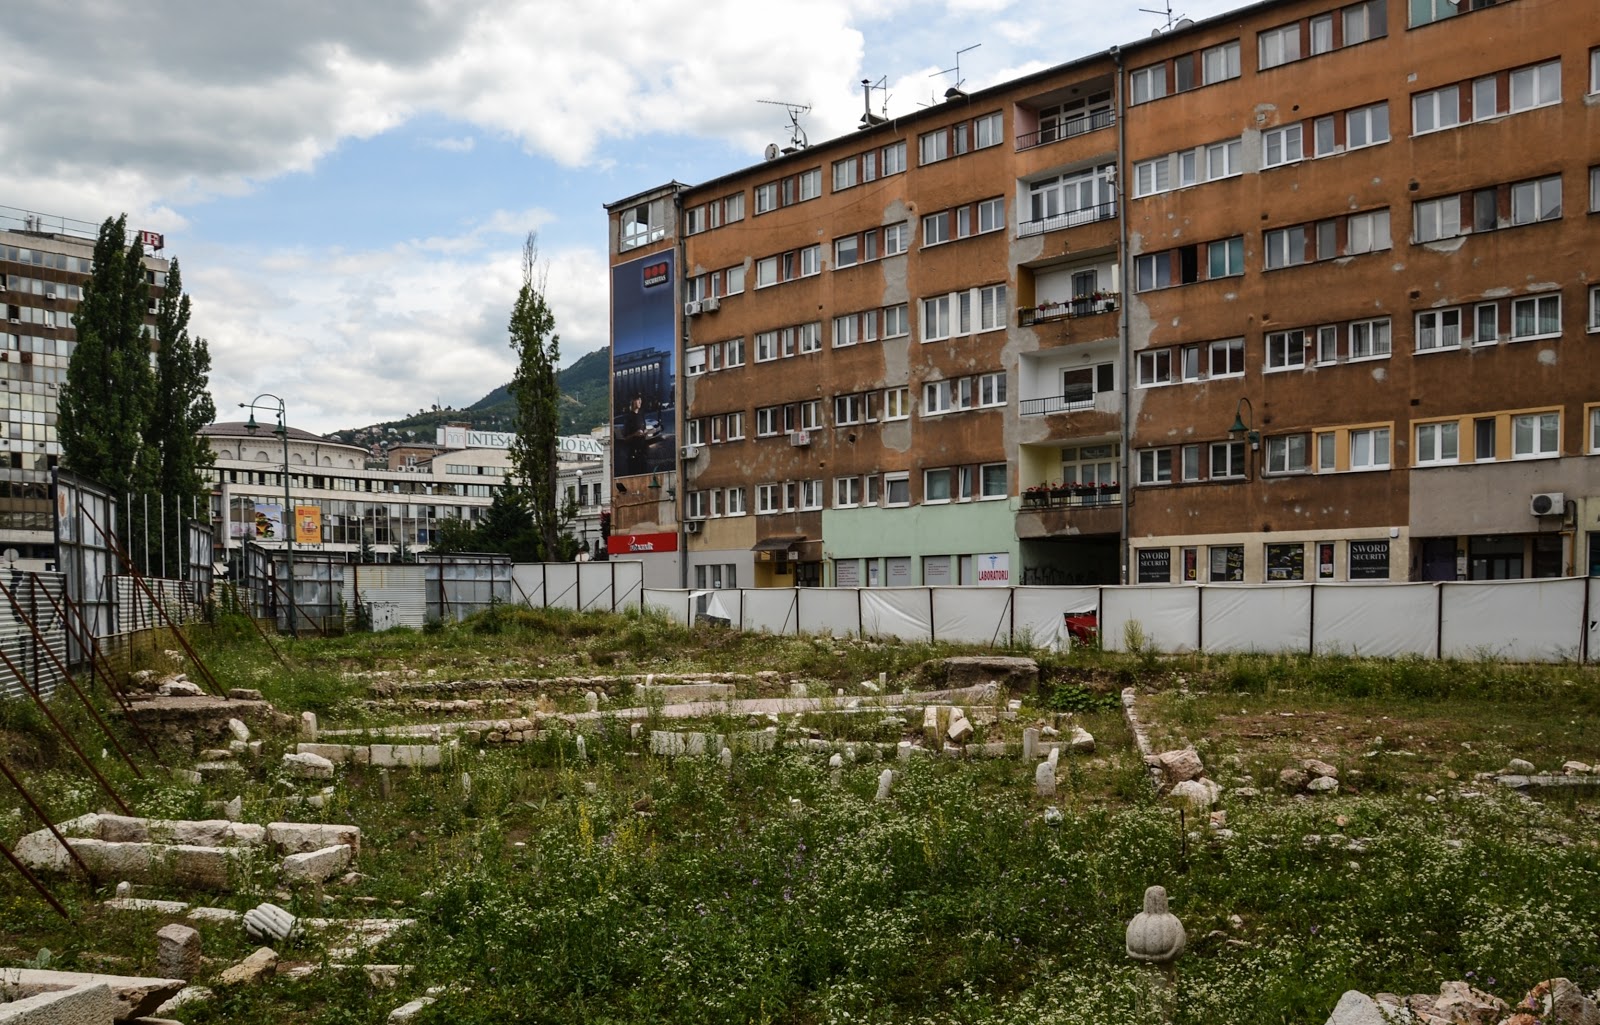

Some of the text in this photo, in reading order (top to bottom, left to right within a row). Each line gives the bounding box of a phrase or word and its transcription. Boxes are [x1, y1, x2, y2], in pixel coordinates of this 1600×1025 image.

[467, 432, 513, 447] INTESA
[579, 440, 603, 453] BAN
[1352, 544, 1388, 553] SWORD
[1140, 552, 1170, 560] SWORD
